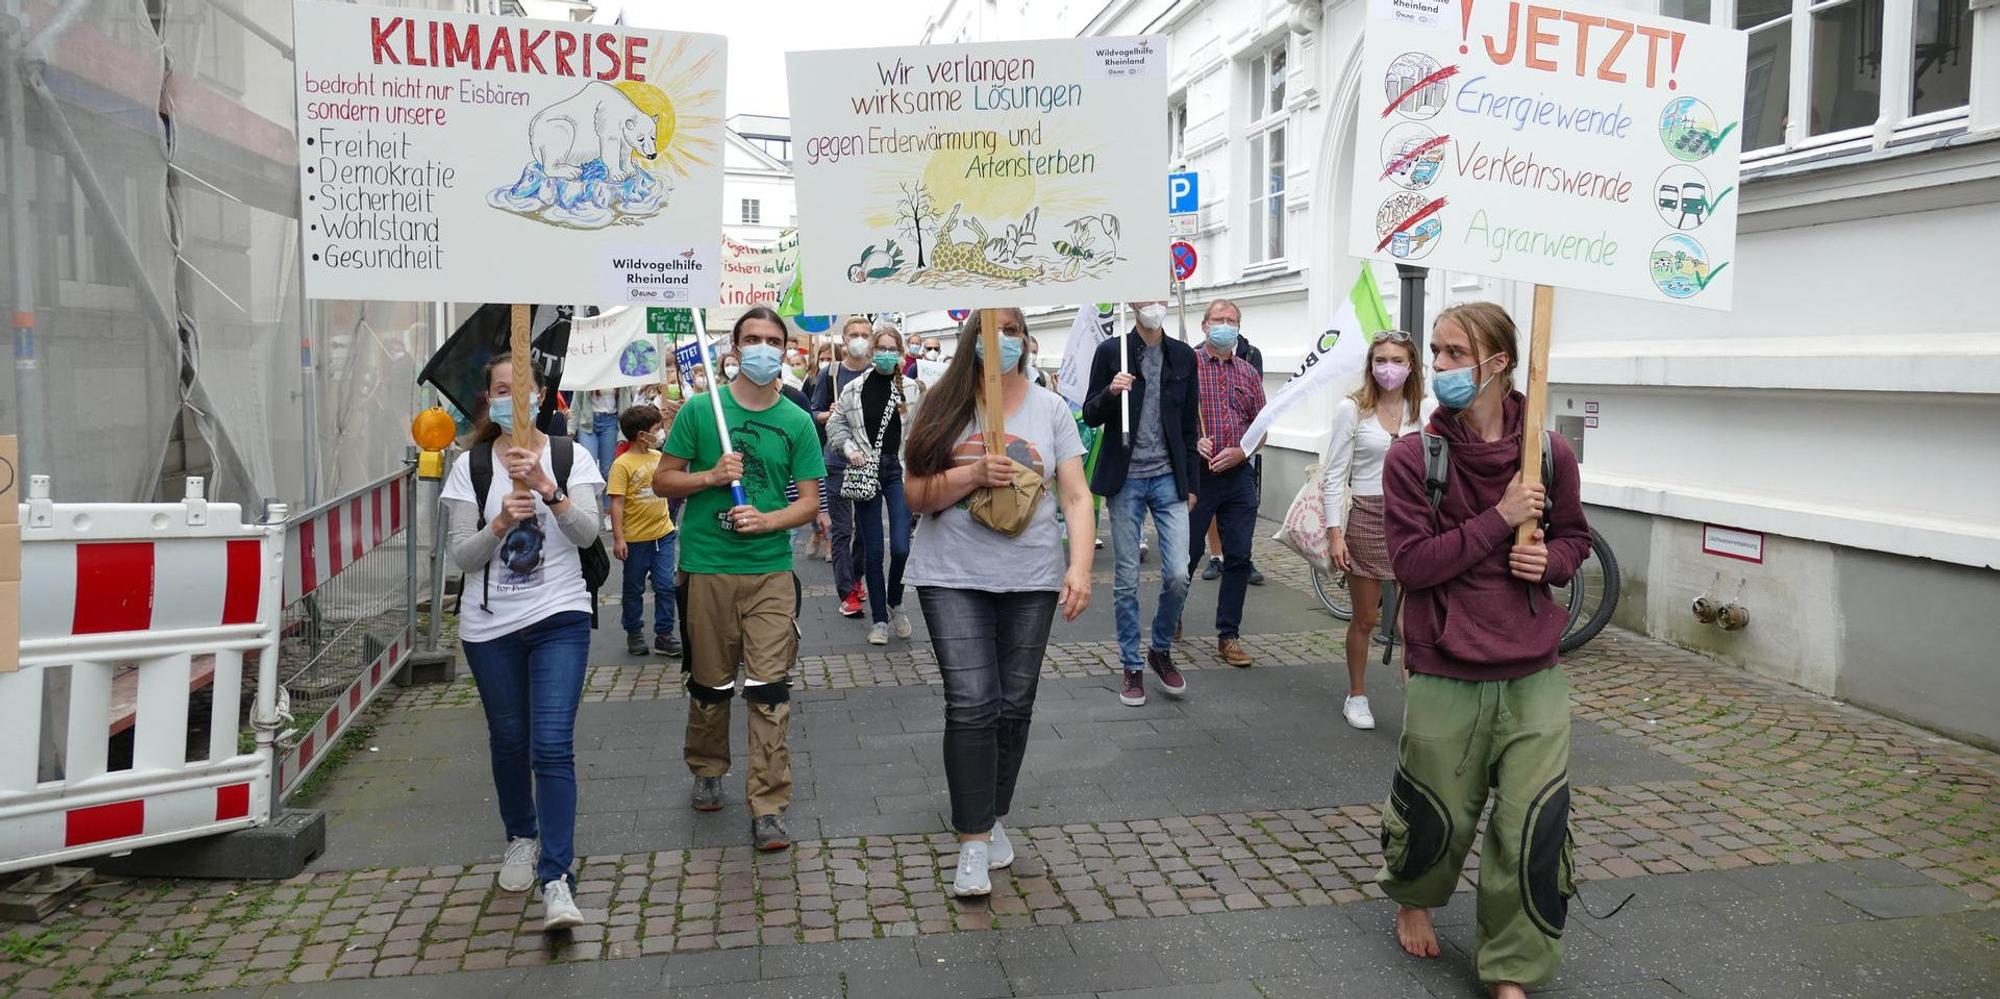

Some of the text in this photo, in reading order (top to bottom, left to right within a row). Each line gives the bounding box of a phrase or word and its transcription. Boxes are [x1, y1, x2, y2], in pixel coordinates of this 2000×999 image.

[370, 16, 649, 83] KLIMAKRISE
[1095, 47, 1154, 57] Wildvogelhilfe
[1105, 57, 1145, 66] Rheinland
[1482, 2, 1687, 91] JETZT!
[876, 54, 1035, 88] Wir verlangen
[304, 72, 530, 106] bedroht nicht nur Eisbären
[851, 80, 1083, 115] wirksame Lösungen
[306, 100, 447, 126] sondern unsere
[1455, 76, 1633, 140] Energiewende
[319, 128, 413, 160] Freiheit
[806, 120, 1042, 166] gegen Erderwärmung und
[319, 157, 456, 188] Demokratie
[965, 150, 1095, 180] Artensterben
[1453, 138, 1633, 204] Verkehrswende
[319, 186, 436, 214] Sicherheit
[1171, 178, 1191, 210] P
[320, 213, 440, 242] Wohlstand
[1463, 208, 1618, 267] Agrarwende
[324, 243, 445, 270] Gesundheit
[612, 258, 703, 272] Wildvogelhilfe
[626, 273, 689, 285] Rheinland
